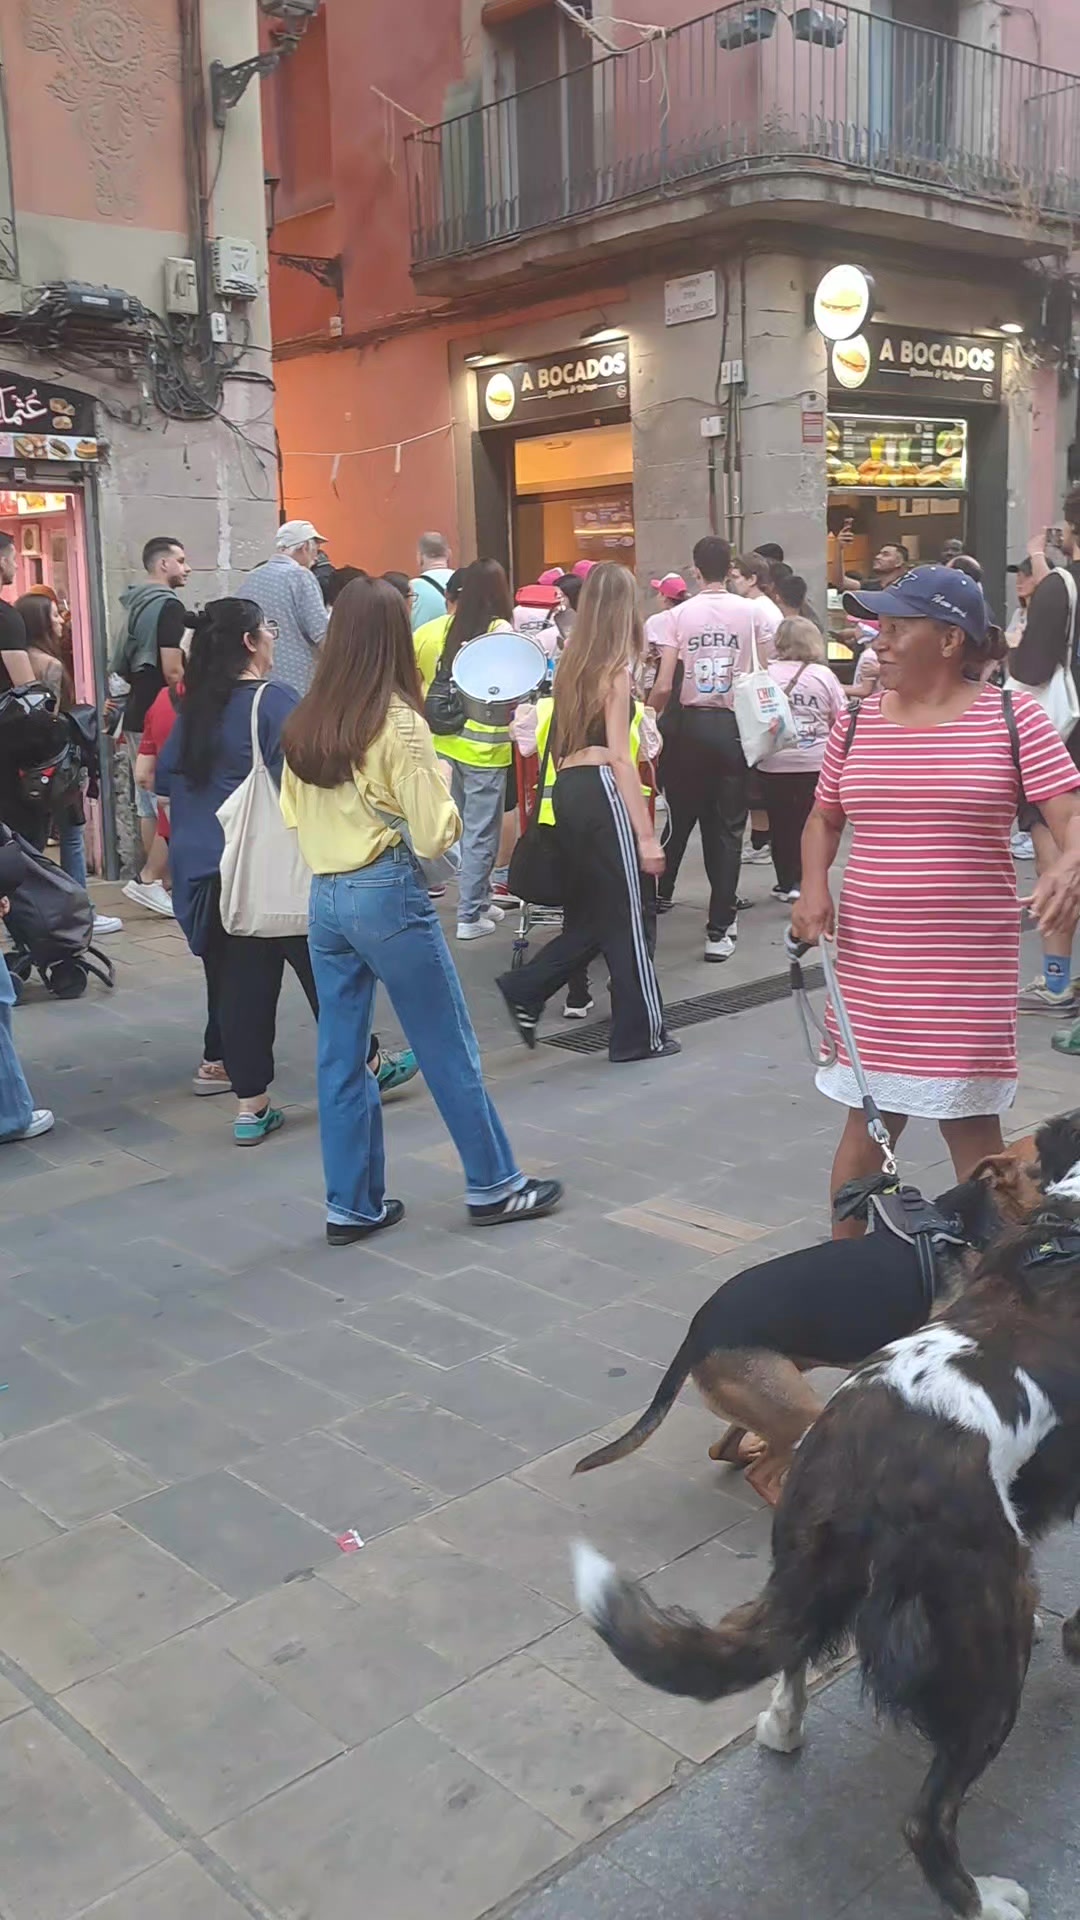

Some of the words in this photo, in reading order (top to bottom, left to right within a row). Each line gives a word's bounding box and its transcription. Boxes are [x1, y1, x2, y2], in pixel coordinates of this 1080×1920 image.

[521, 372, 534, 392] A
[538, 352, 626, 389] BOCADOS
[879, 338, 895, 361] A
[901, 340, 995, 372] BOCADOS
[688, 633, 740, 651] SCRA
